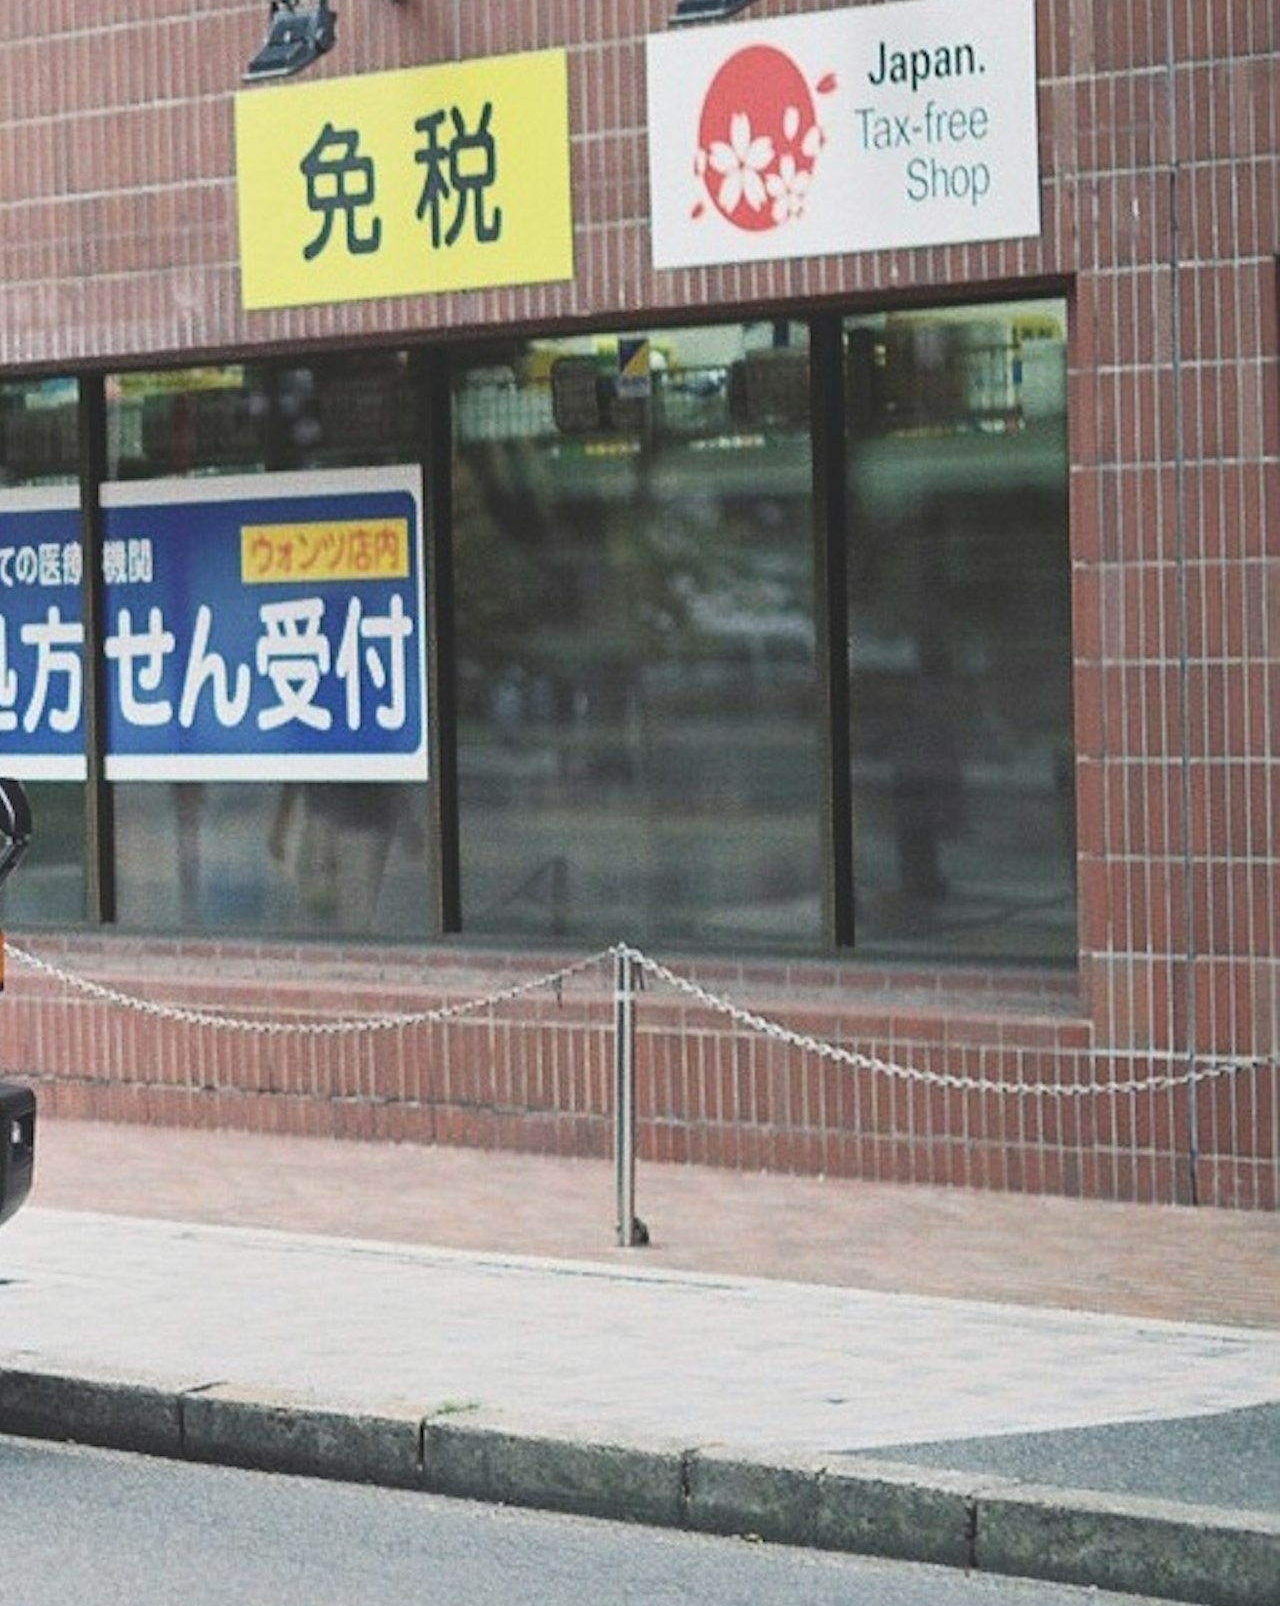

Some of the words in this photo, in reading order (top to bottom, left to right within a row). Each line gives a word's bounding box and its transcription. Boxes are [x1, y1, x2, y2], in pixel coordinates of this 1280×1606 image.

[867, 41, 986, 92] Japan.
[854, 100, 988, 150] Tax-free
[299, 100, 503, 262] 免税
[906, 157, 991, 207] Shop
